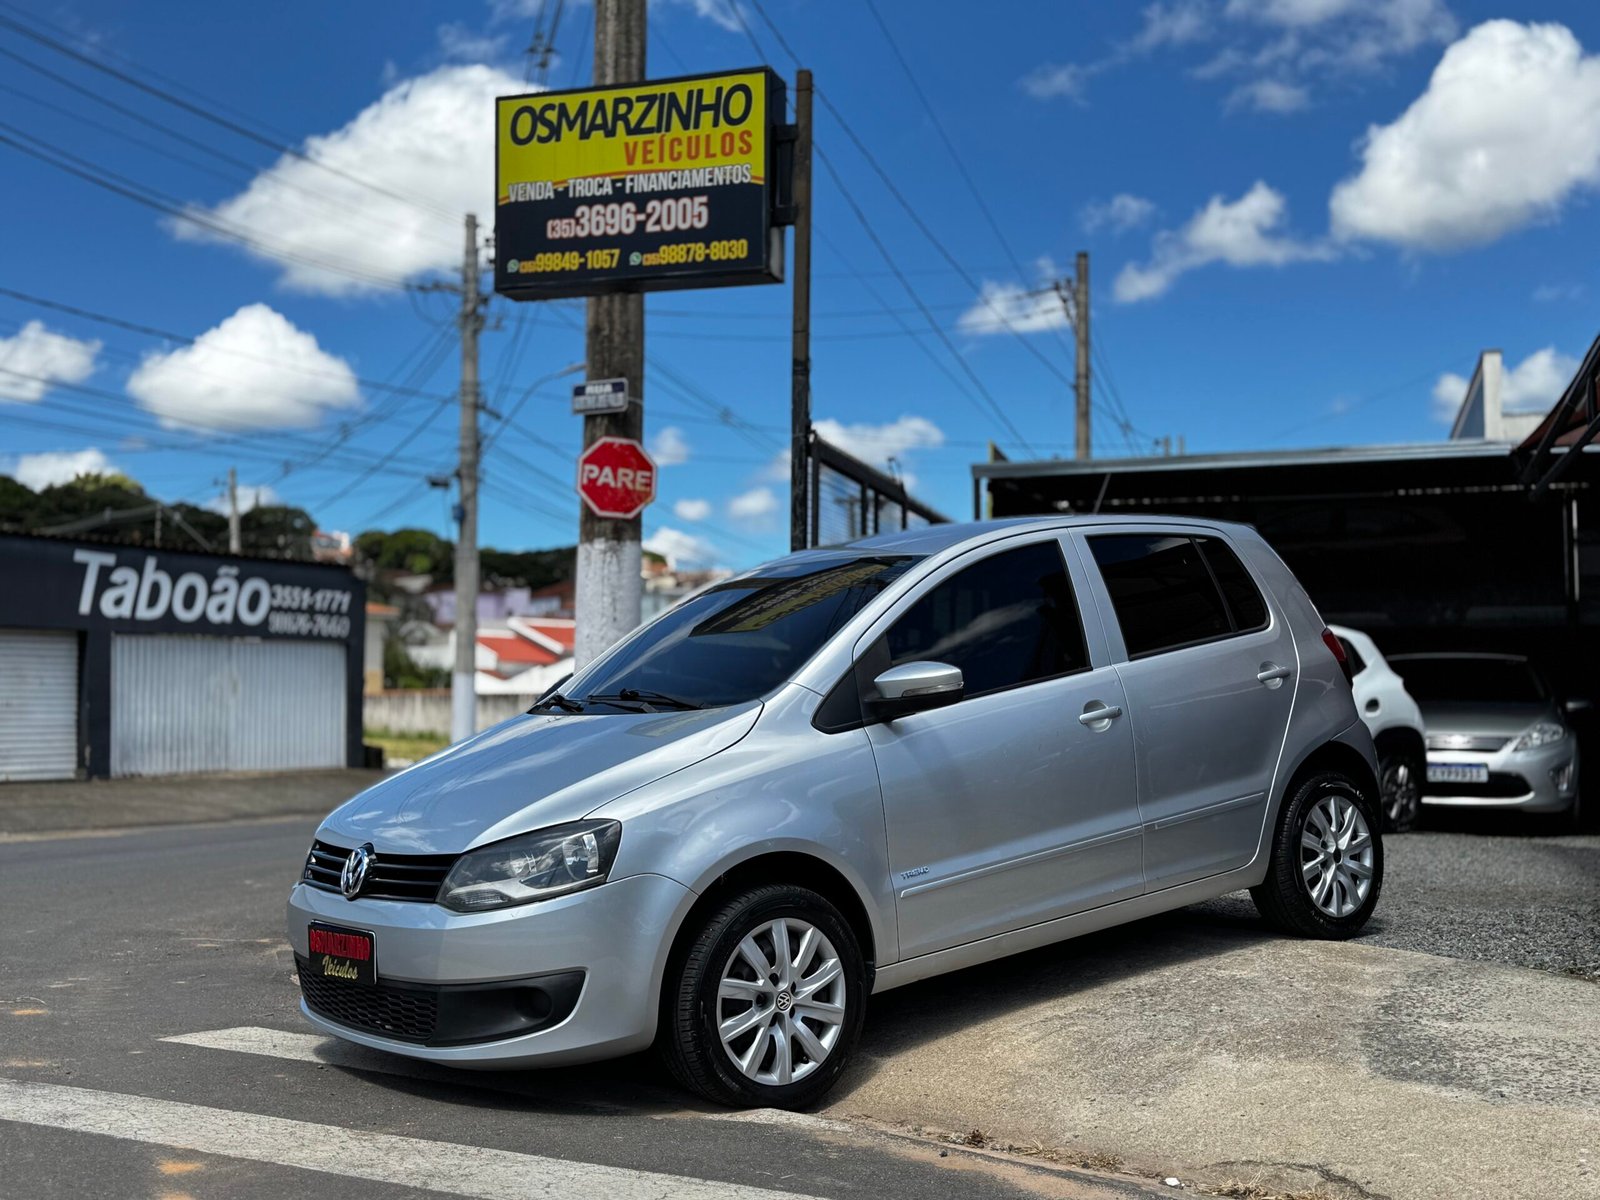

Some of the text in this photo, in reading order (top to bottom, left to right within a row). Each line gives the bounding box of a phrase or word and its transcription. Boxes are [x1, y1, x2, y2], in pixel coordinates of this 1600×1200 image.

[510, 83, 753, 146] OSMARZINHO
[623, 129, 753, 166] VEÍCULOS
[508, 181, 555, 203] VENDA
[567, 176, 613, 199] TROCA
[625, 163, 752, 195] FINANCIAMENTOS
[582, 463, 652, 492] PARE
[73, 548, 272, 626] Taboão
